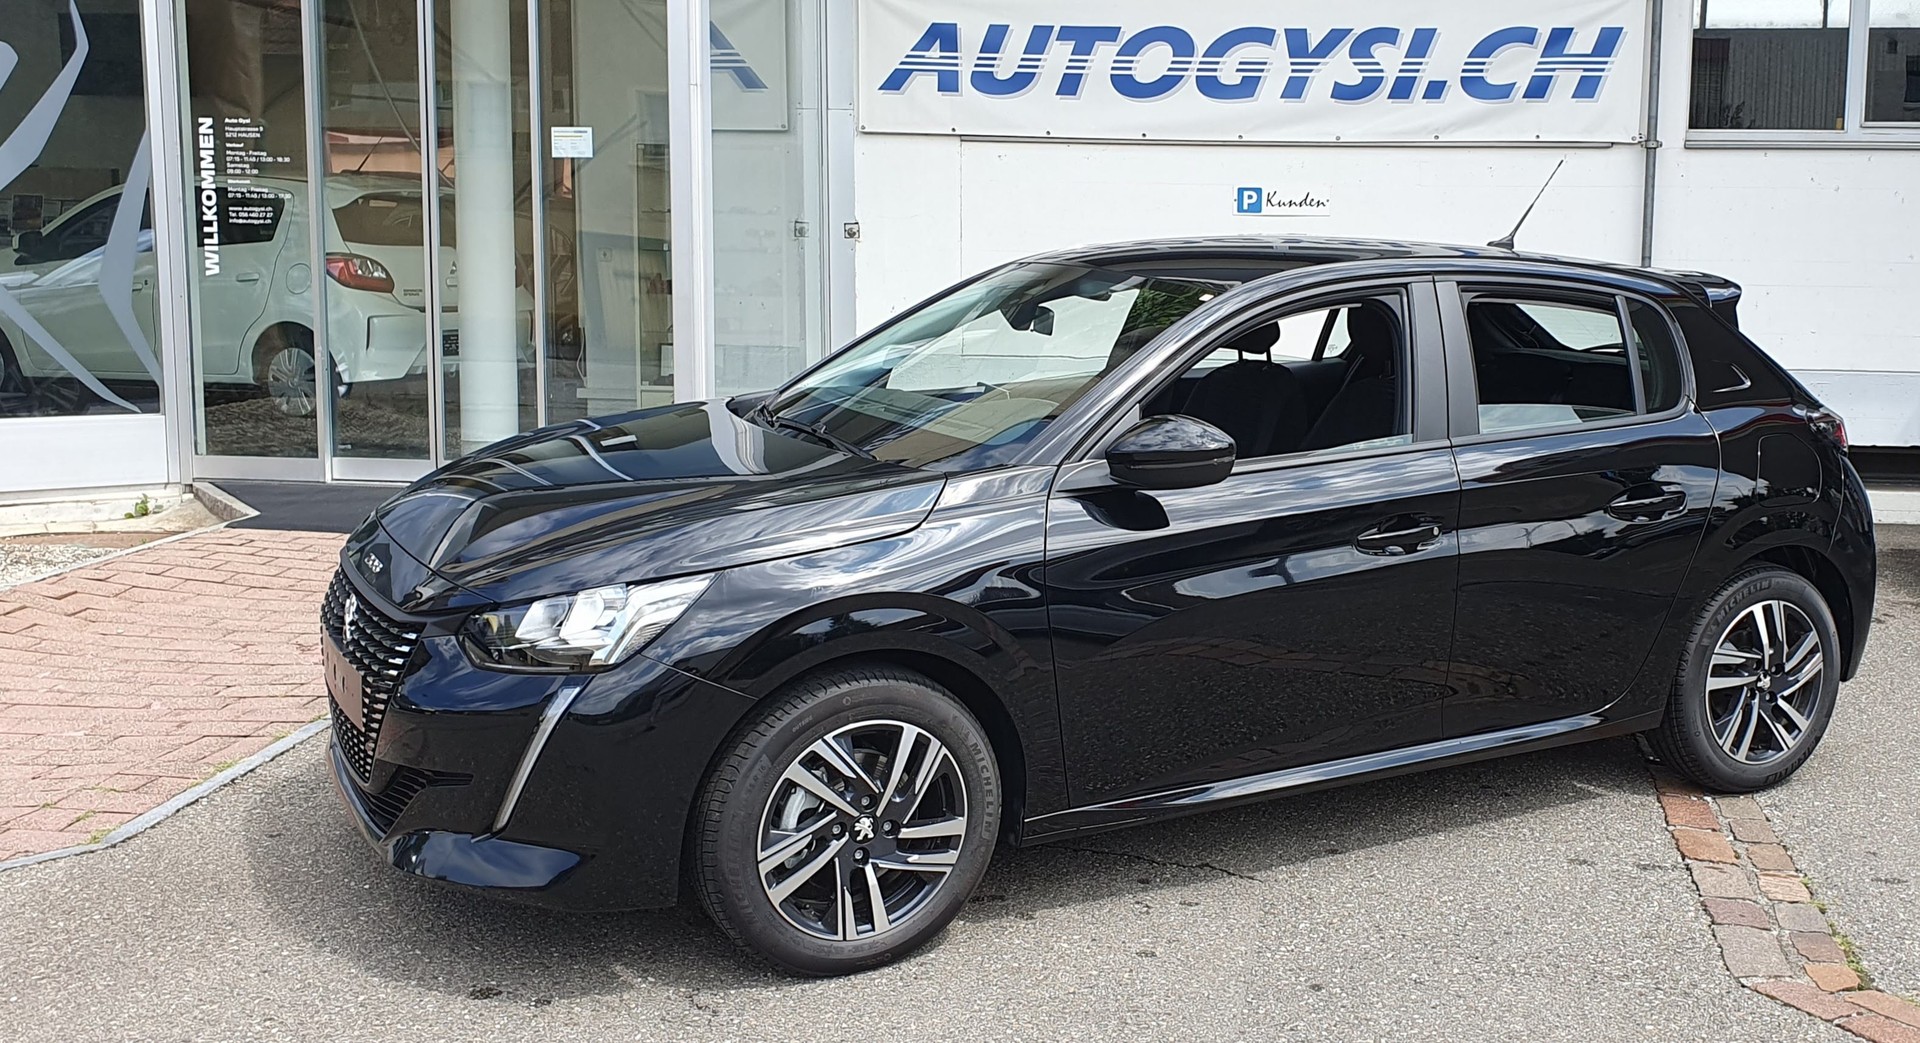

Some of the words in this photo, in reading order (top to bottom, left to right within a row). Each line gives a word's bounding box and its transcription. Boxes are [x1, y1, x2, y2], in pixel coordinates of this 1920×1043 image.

[878, 22, 1627, 102] AUTOGYSI.CH
[198, 117, 220, 276] WILLKOMMEN
[1265, 190, 1326, 208] Kunden
[969, 741, 995, 836] MICHELIN
